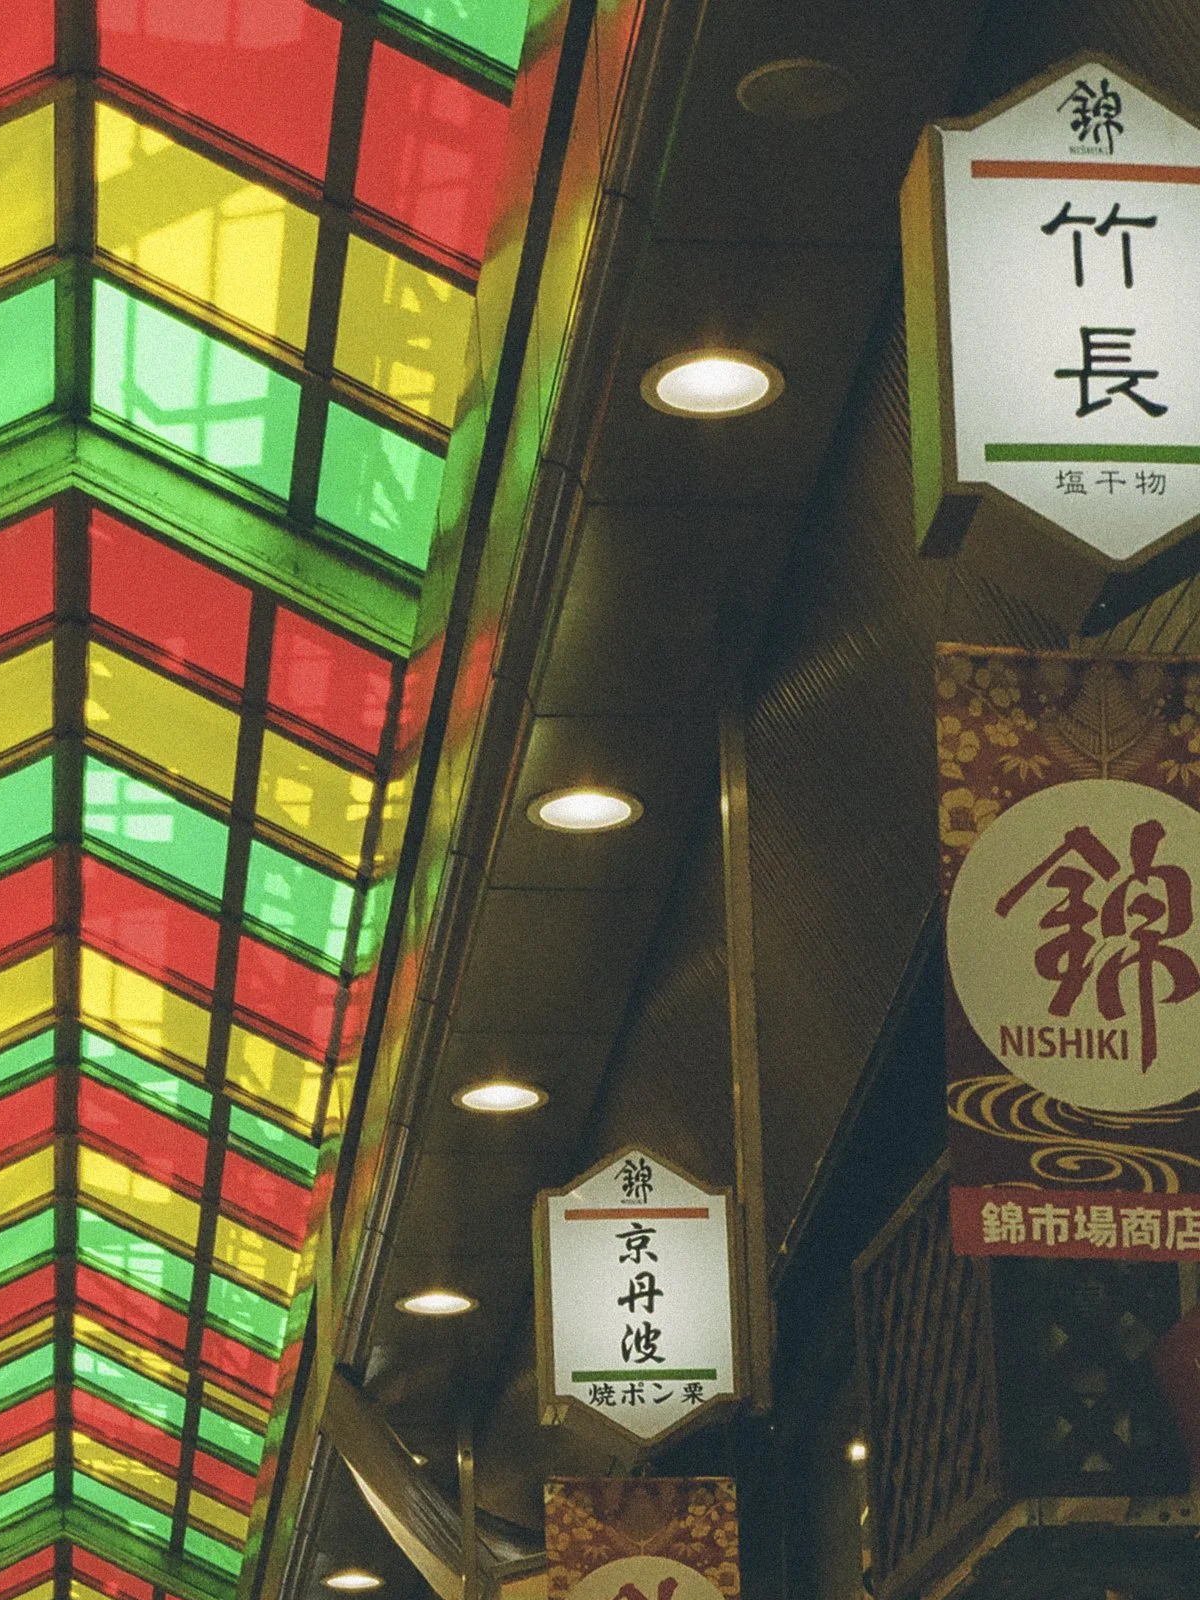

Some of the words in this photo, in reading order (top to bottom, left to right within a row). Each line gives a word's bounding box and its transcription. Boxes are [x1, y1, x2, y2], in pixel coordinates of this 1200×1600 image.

[1057, 79, 1124, 155] 錦
[1041, 201, 1168, 418] 竹長
[1056, 469, 1167, 497] 塩干物
[994, 819, 1200, 1075] 錦
[1000, 1024, 1129, 1062] NISHIKI
[614, 1159, 654, 1204] 錦
[981, 1200, 1200, 1251] 錦市場商店
[615, 1222, 667, 1364] 京丹波
[588, 1382, 704, 1406] 焼ポン栗
